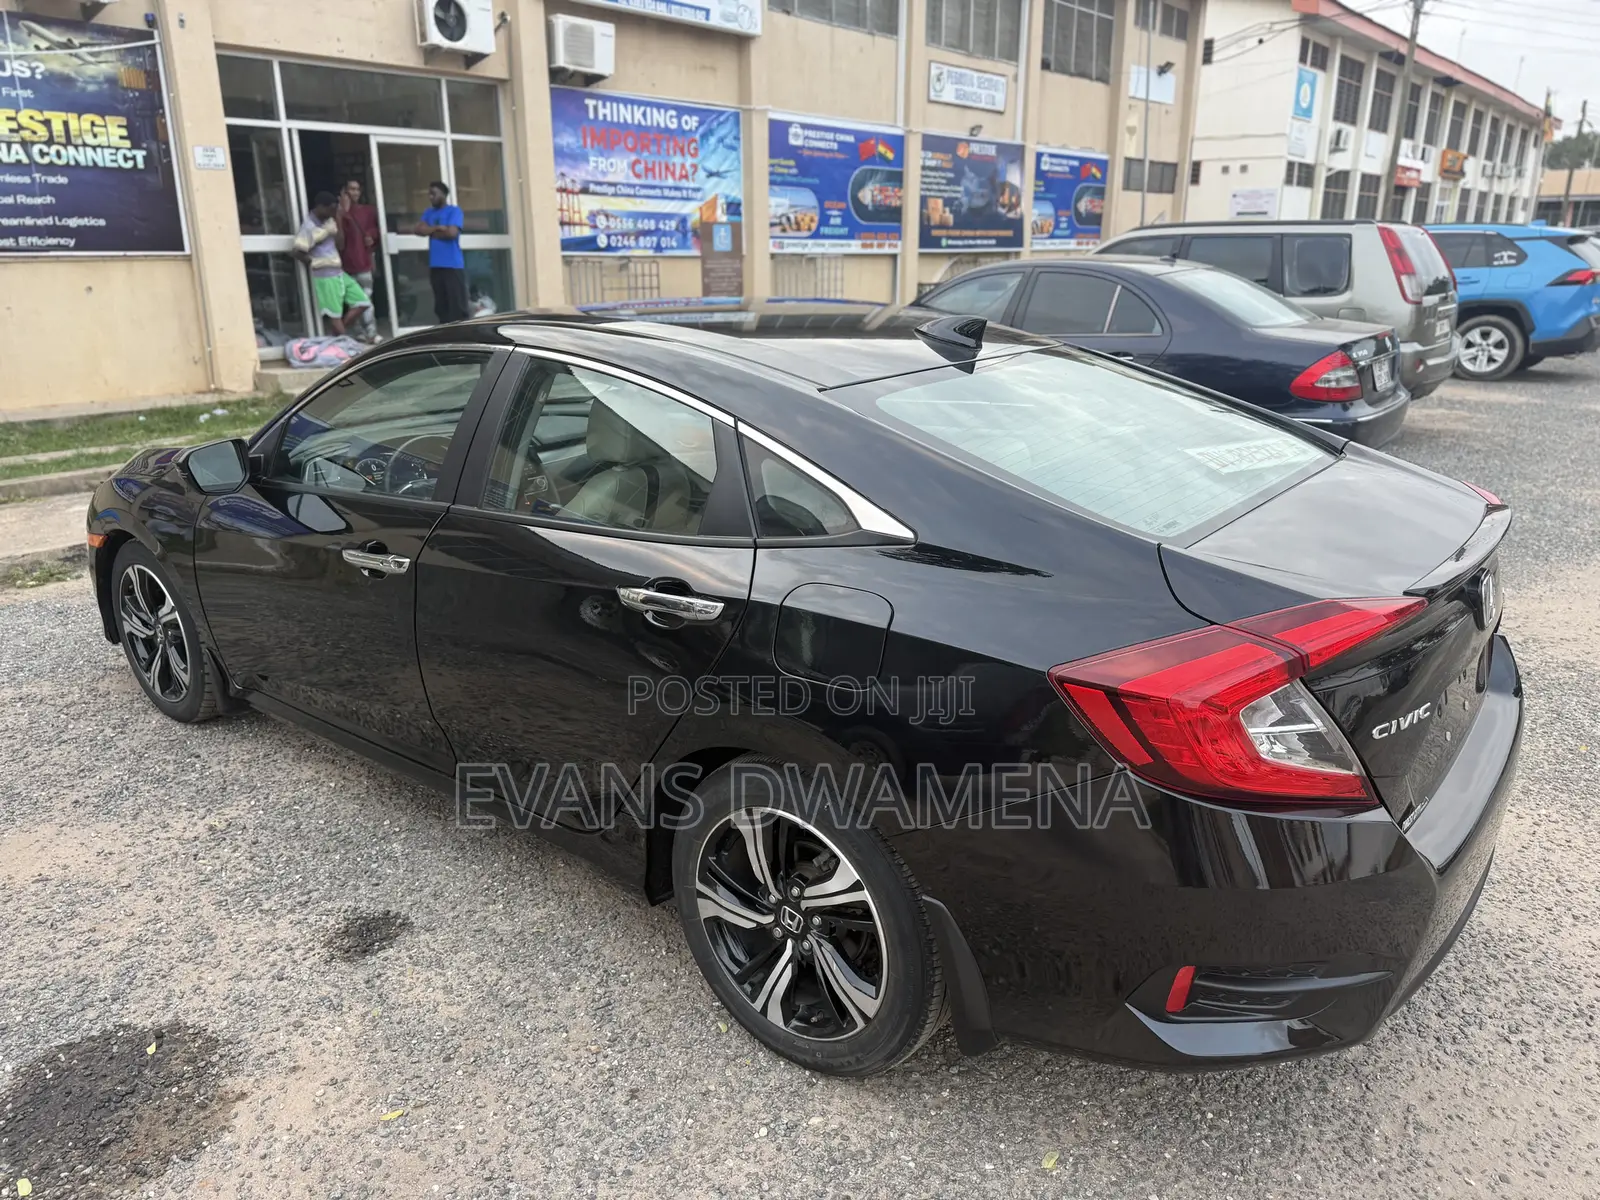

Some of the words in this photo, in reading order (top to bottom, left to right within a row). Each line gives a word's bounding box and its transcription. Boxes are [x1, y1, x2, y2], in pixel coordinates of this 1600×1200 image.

[2, 86, 35, 98] First
[584, 98, 678, 130] THINKING
[681, 114, 700, 131] OF
[581, 125, 699, 159] IMPORTING
[32, 143, 147, 170] CONNECT
[32, 172, 69, 185] Trade
[588, 156, 627, 173] FROM
[631, 158, 699, 183] CHINA?
[16, 194, 56, 205] Reach
[54, 216, 107, 228] Logistics
[18, 236, 76, 248] Efficiency
[1371, 702, 1431, 741] CIVIC
